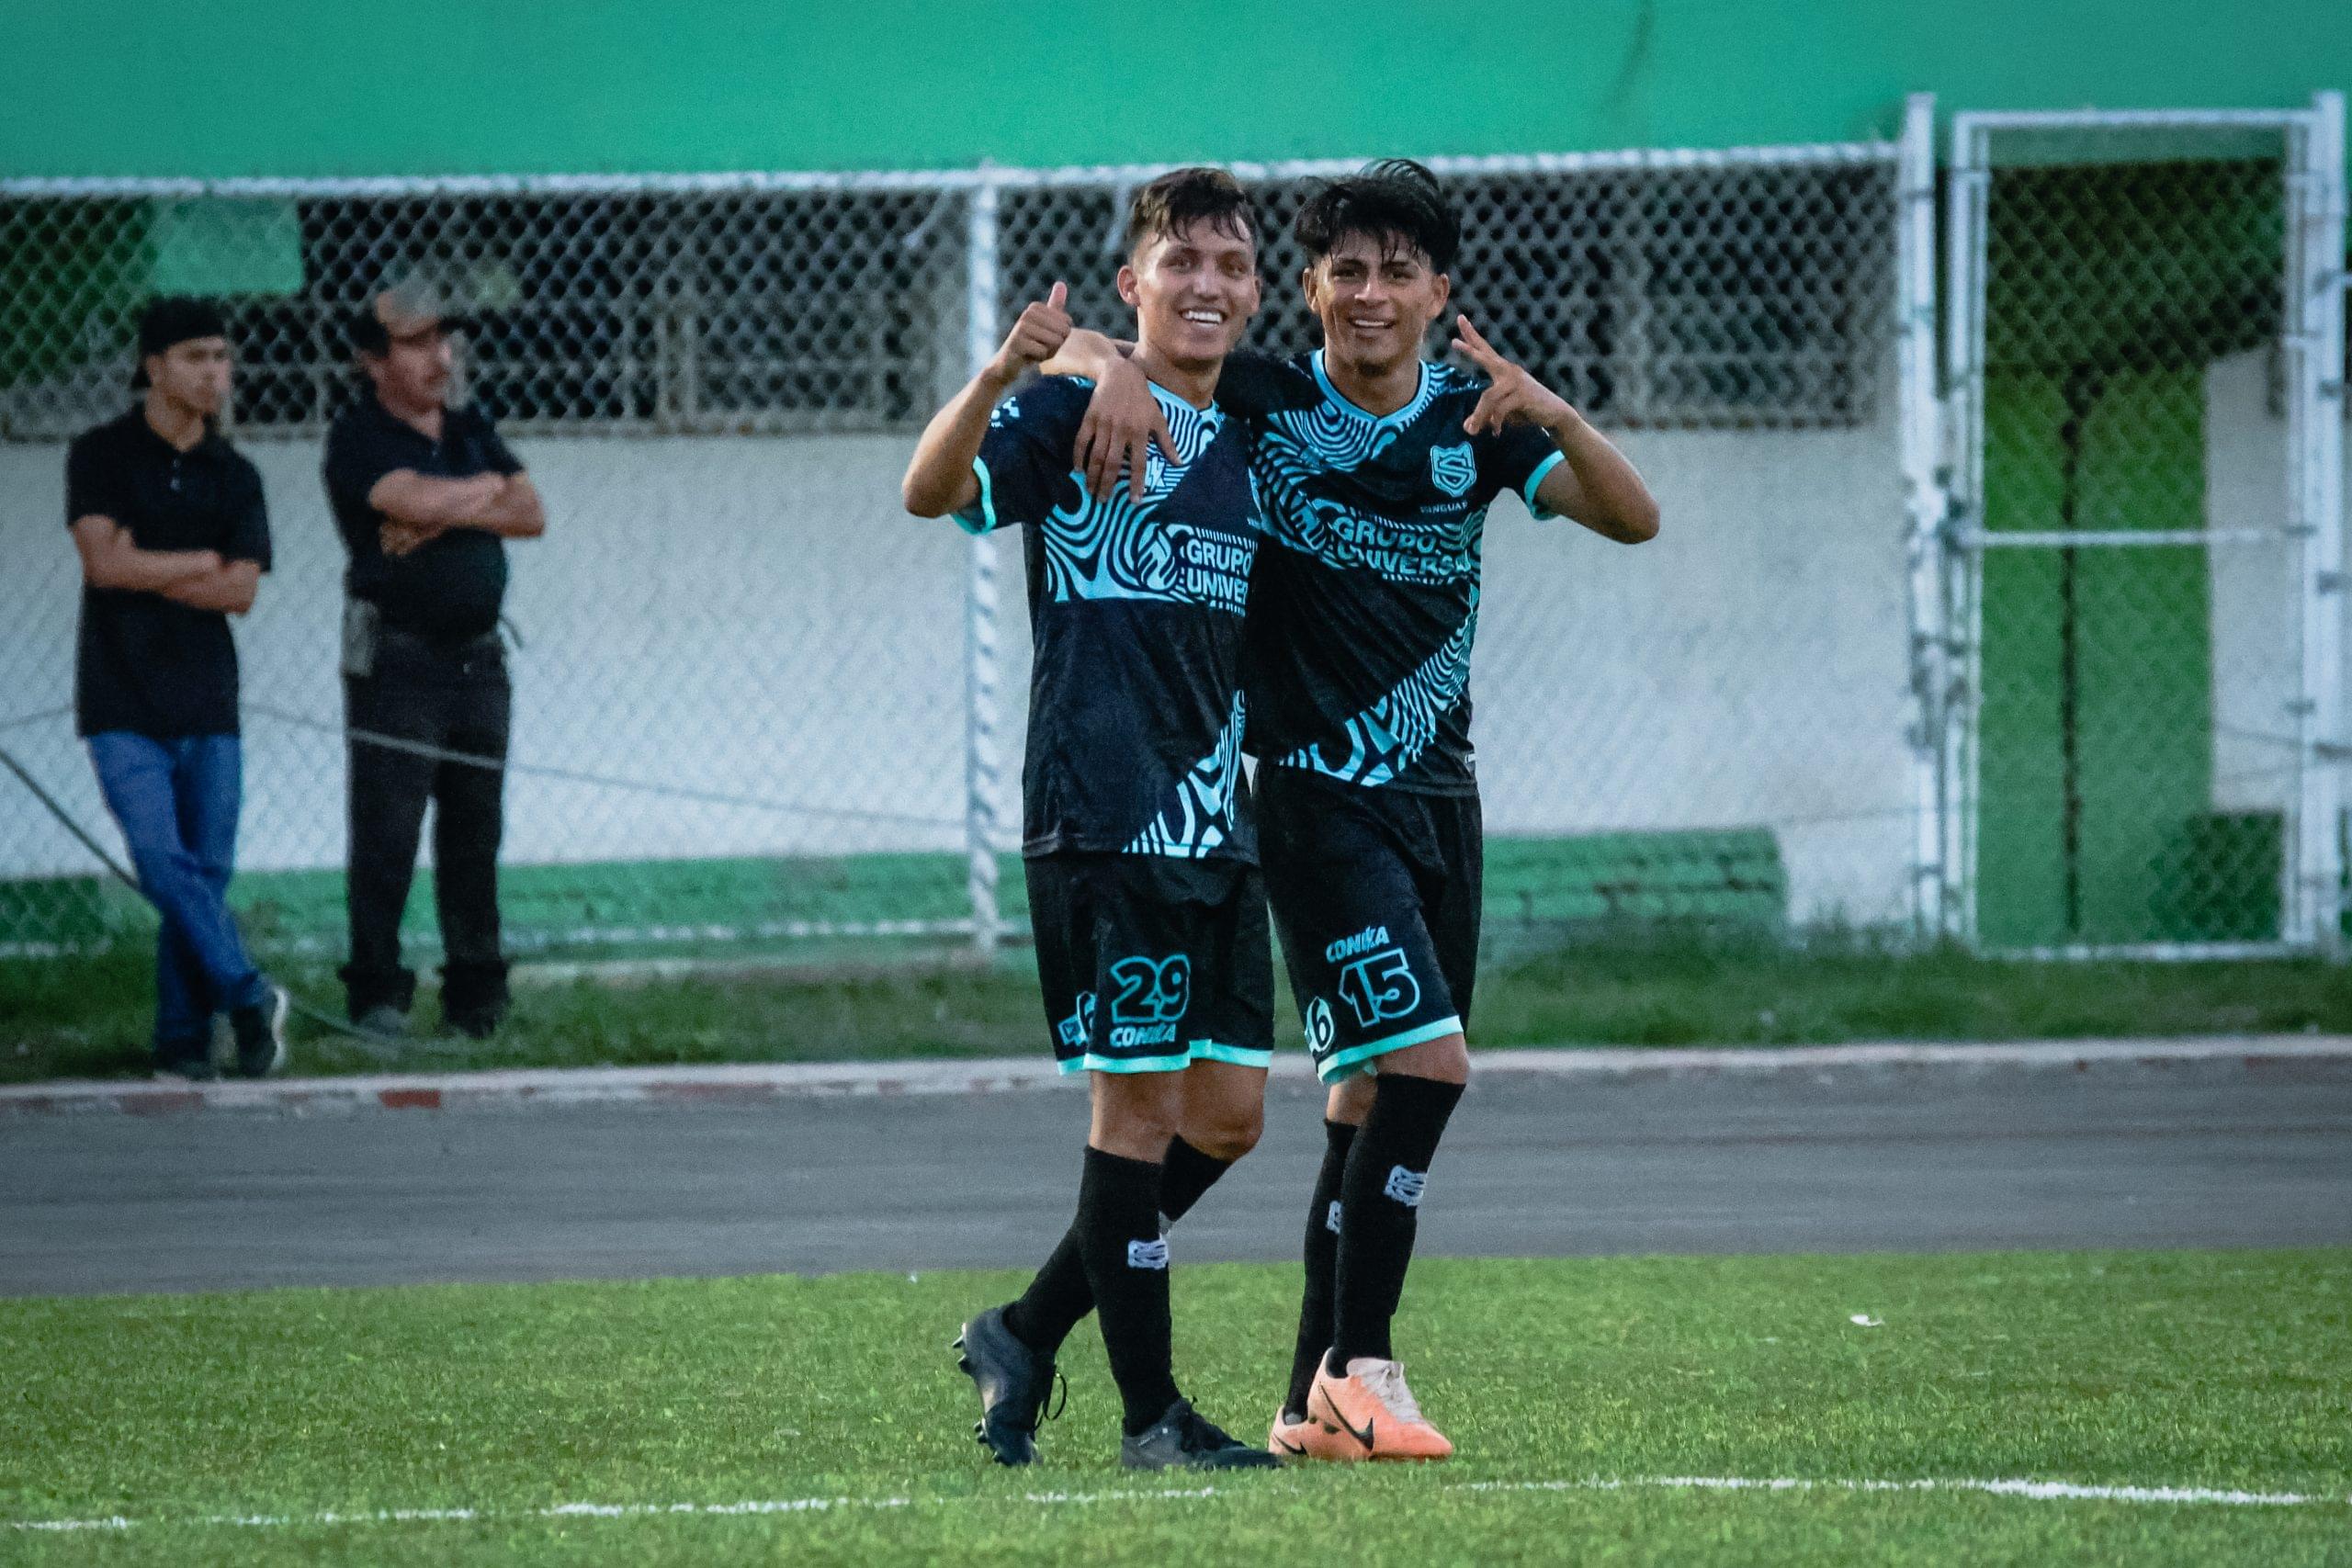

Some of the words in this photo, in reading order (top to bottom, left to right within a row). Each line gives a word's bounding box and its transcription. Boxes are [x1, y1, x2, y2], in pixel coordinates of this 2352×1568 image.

[1186, 538, 1251, 578] GRUPO
[1110, 953, 1191, 1024] 29
[1338, 947, 1420, 1028] 15
